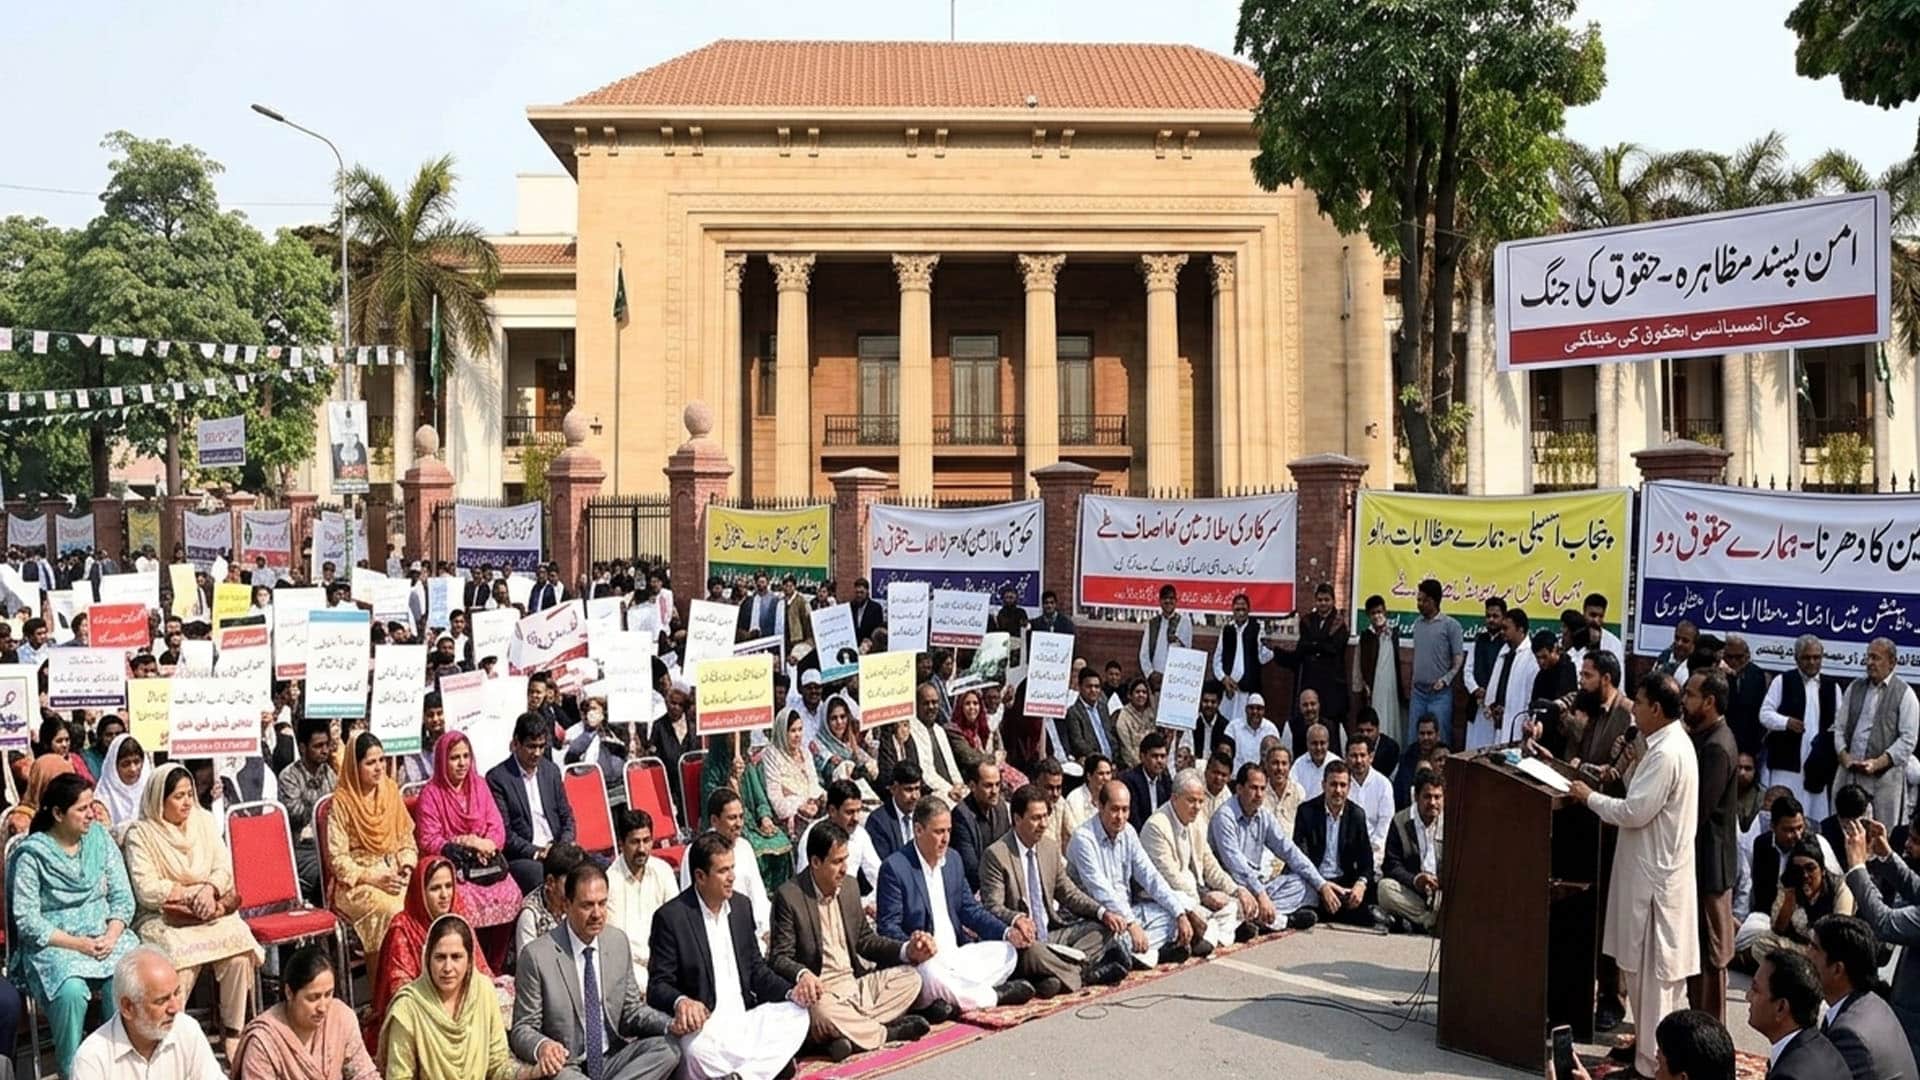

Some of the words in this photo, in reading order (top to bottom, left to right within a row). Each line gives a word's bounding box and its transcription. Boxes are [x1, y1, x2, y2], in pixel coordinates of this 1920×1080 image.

[1576, 245, 1606, 308] کی
[1676, 244, 1751, 300] مظاہرہ
[1753, 238, 1800, 289] پسند
[1805, 223, 1858, 282] امن
[1520, 256, 1570, 308] جنگ
[1602, 254, 1660, 306] حقوق
[1676, 511, 1732, 562] حقوق
[1726, 523, 1798, 561] ہمارے
[1870, 518, 1895, 564] کا
